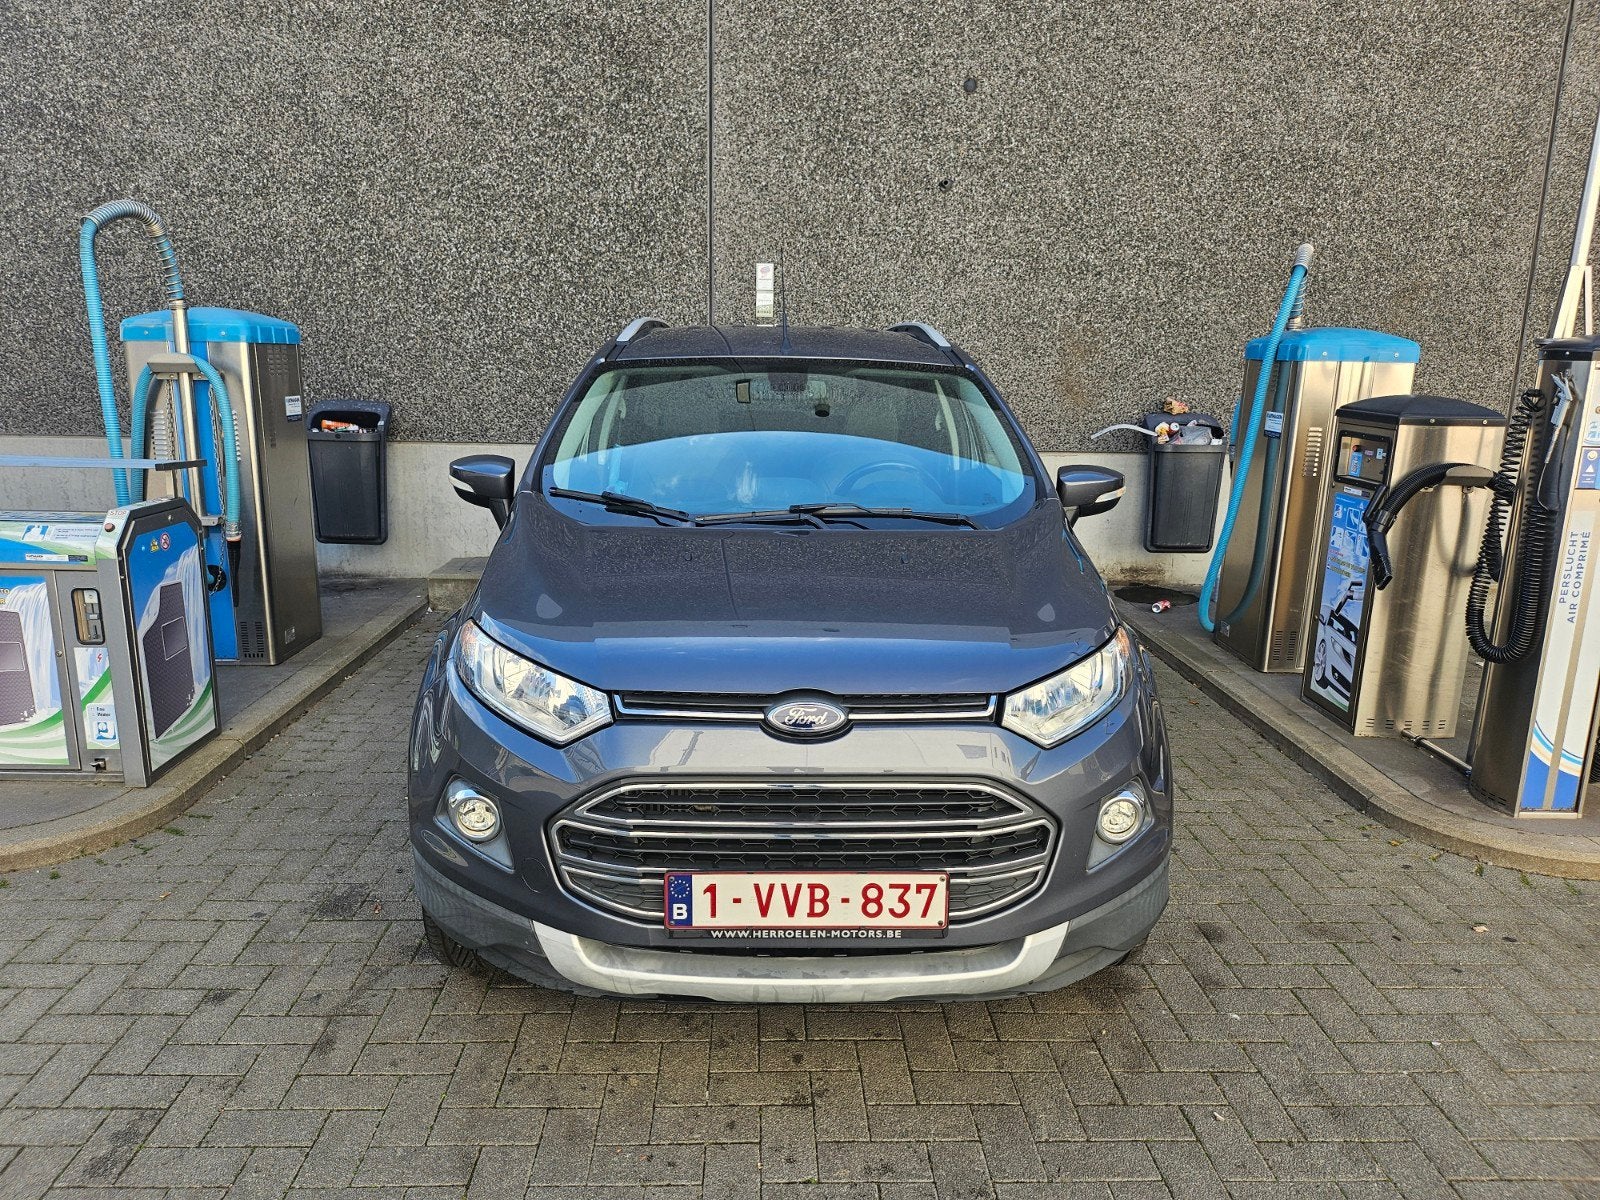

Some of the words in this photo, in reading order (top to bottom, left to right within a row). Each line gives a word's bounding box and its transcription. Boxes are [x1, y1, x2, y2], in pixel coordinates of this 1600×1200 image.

[1558, 531, 1579, 604] PERSLUCHT
[1571, 531, 1591, 598] COMPRIMÉ
[1567, 603, 1578, 624] AIR
[784, 707, 829, 725] Ford
[672, 903, 688, 920] B
[710, 929, 902, 939] WWW.HERROELEN-MOTORS.BE
